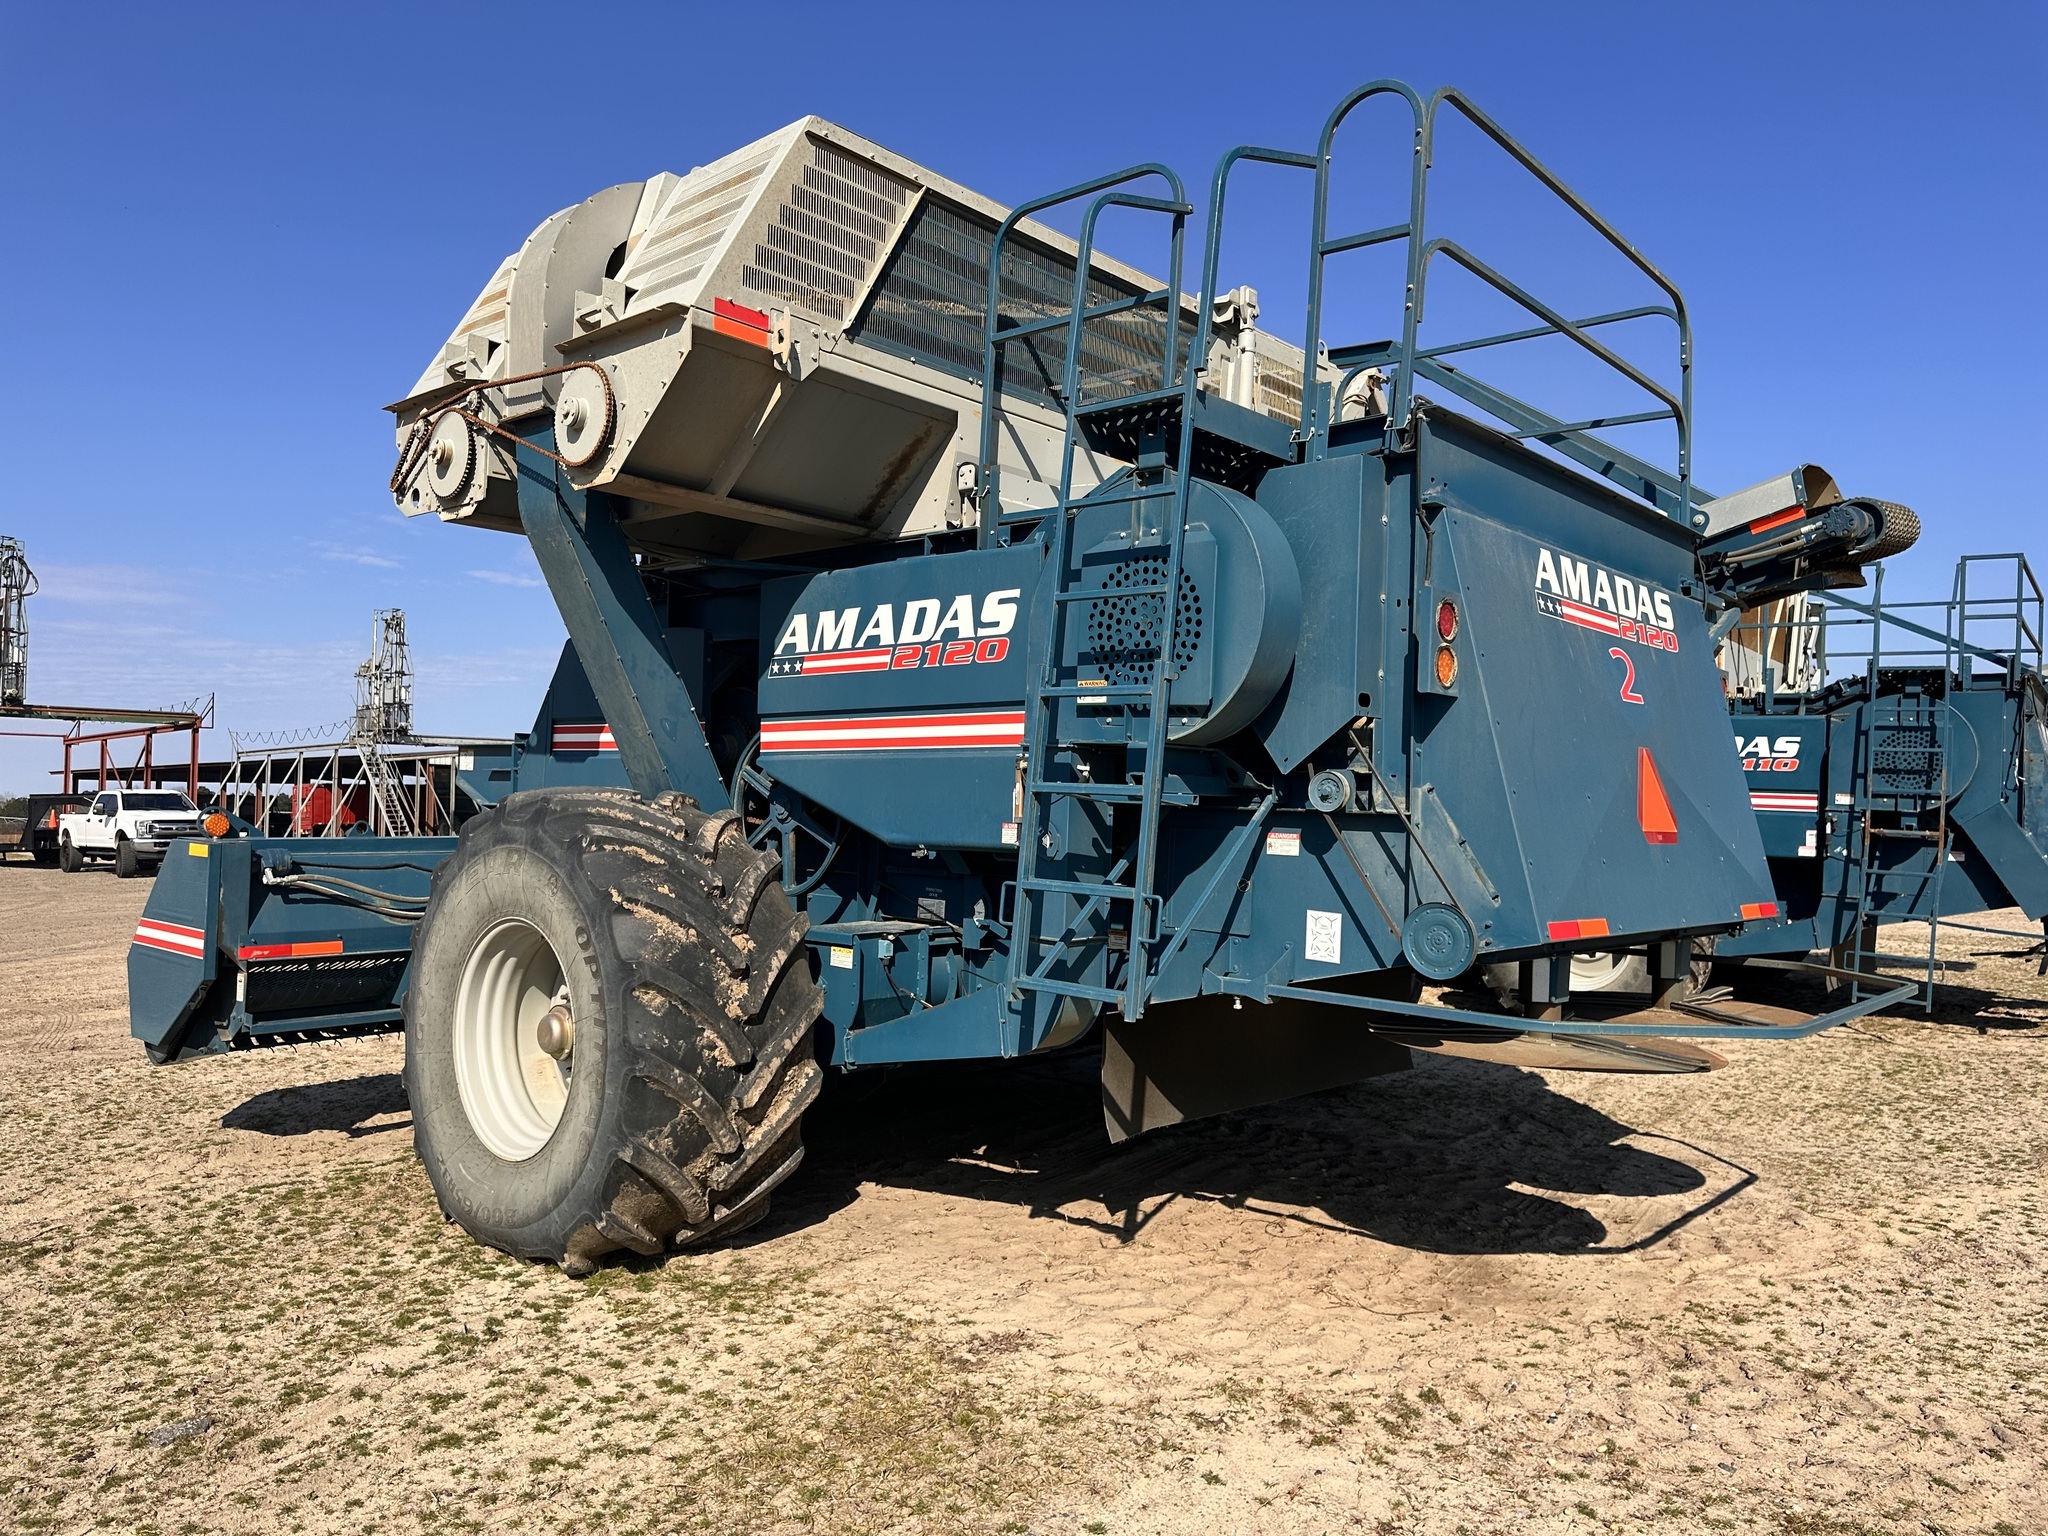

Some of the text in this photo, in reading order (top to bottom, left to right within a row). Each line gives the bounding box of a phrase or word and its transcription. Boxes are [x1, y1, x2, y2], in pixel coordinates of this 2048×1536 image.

[1535, 548, 1675, 631] AMADAS
[774, 588, 1021, 655] AMADAS
[1619, 616, 1679, 653] 2120
[891, 637, 1010, 670] 2120
[1608, 647, 1644, 704] 2
